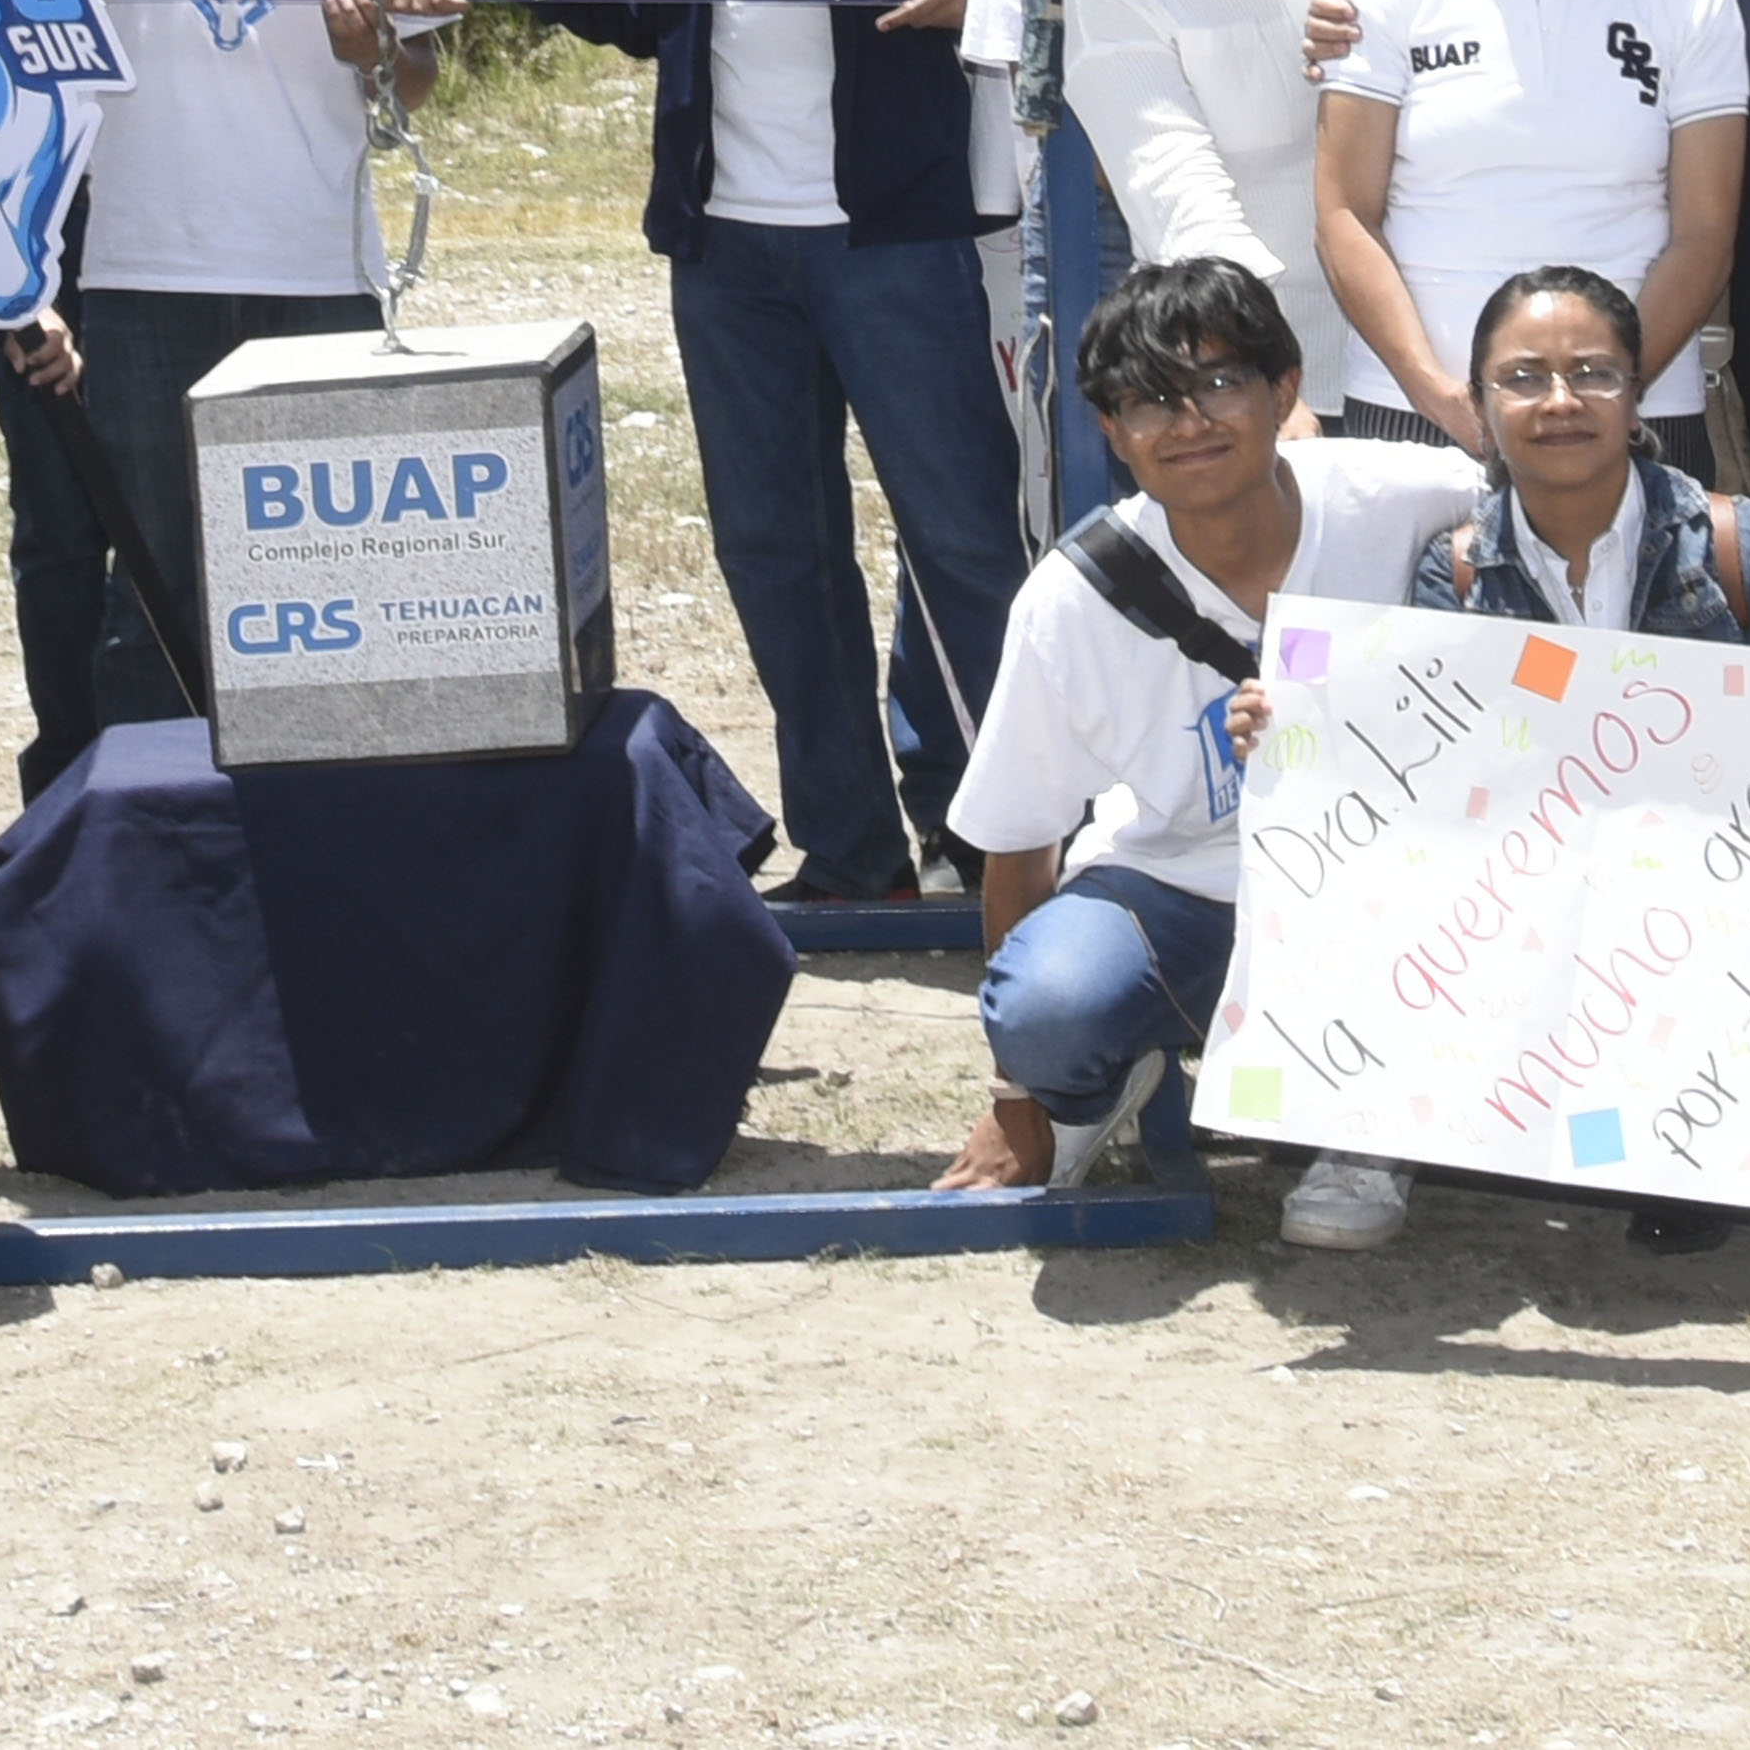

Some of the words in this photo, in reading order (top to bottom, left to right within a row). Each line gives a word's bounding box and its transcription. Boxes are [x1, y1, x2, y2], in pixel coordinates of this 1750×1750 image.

[7, 23, 110, 75] SUR
[1410, 41, 1480, 73] BUAP
[242, 452, 509, 531] BUAP
[248, 542, 354, 563] Complejo
[362, 535, 462, 560] Regional
[468, 531, 507, 550] Sur
[228, 600, 362, 656] CRS
[379, 591, 544, 623] TEHUACÁN
[397, 625, 540, 646] PREPARATORIA
[1344, 657, 1485, 803] Lili
[1263, 1010, 1386, 1090] la
[1393, 681, 1692, 1016] queremos
[1485, 907, 1692, 1132] mucho
[1653, 1050, 1739, 1170] por
